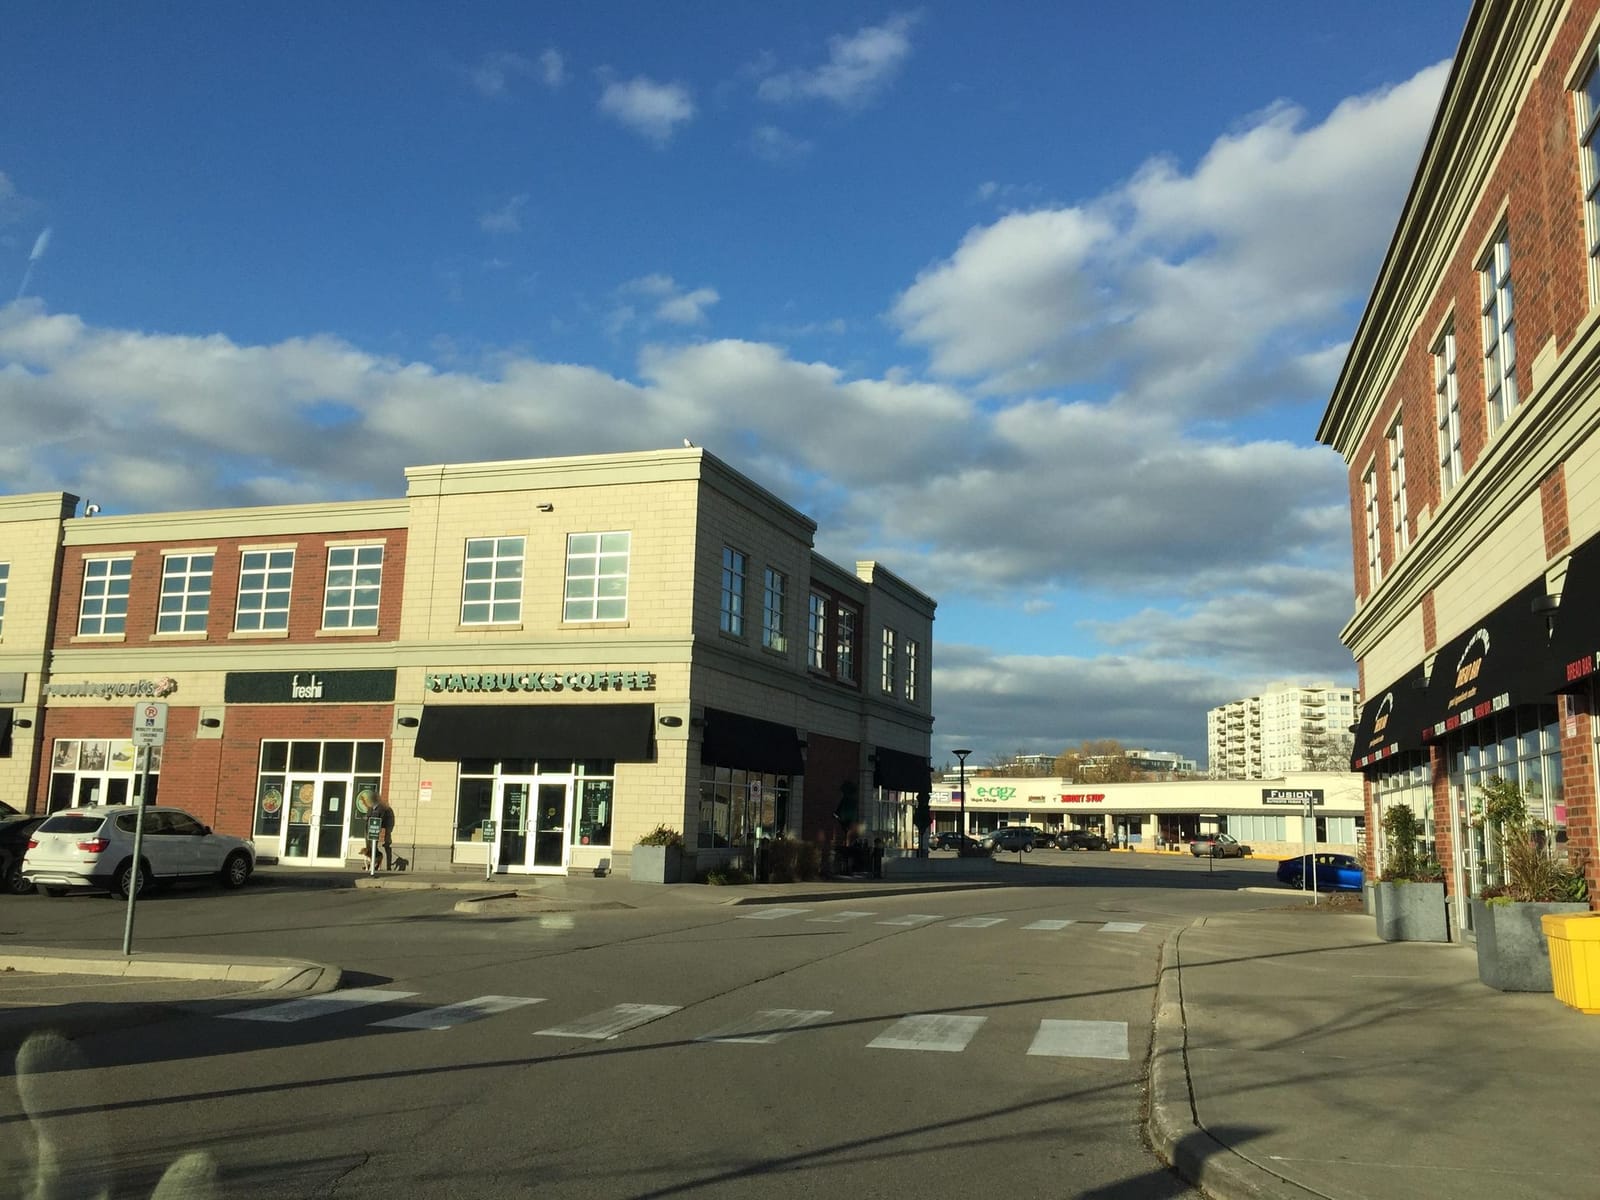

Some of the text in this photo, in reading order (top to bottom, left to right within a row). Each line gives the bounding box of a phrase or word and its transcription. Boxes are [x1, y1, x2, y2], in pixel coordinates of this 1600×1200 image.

[1566, 659, 1582, 681] BREAD
[1582, 655, 1593, 676] BAR
[292, 674, 323, 698] freshii
[425, 670, 651, 691] STARBUCKS COFFEE
[1271, 790, 1313, 798] FUSION
